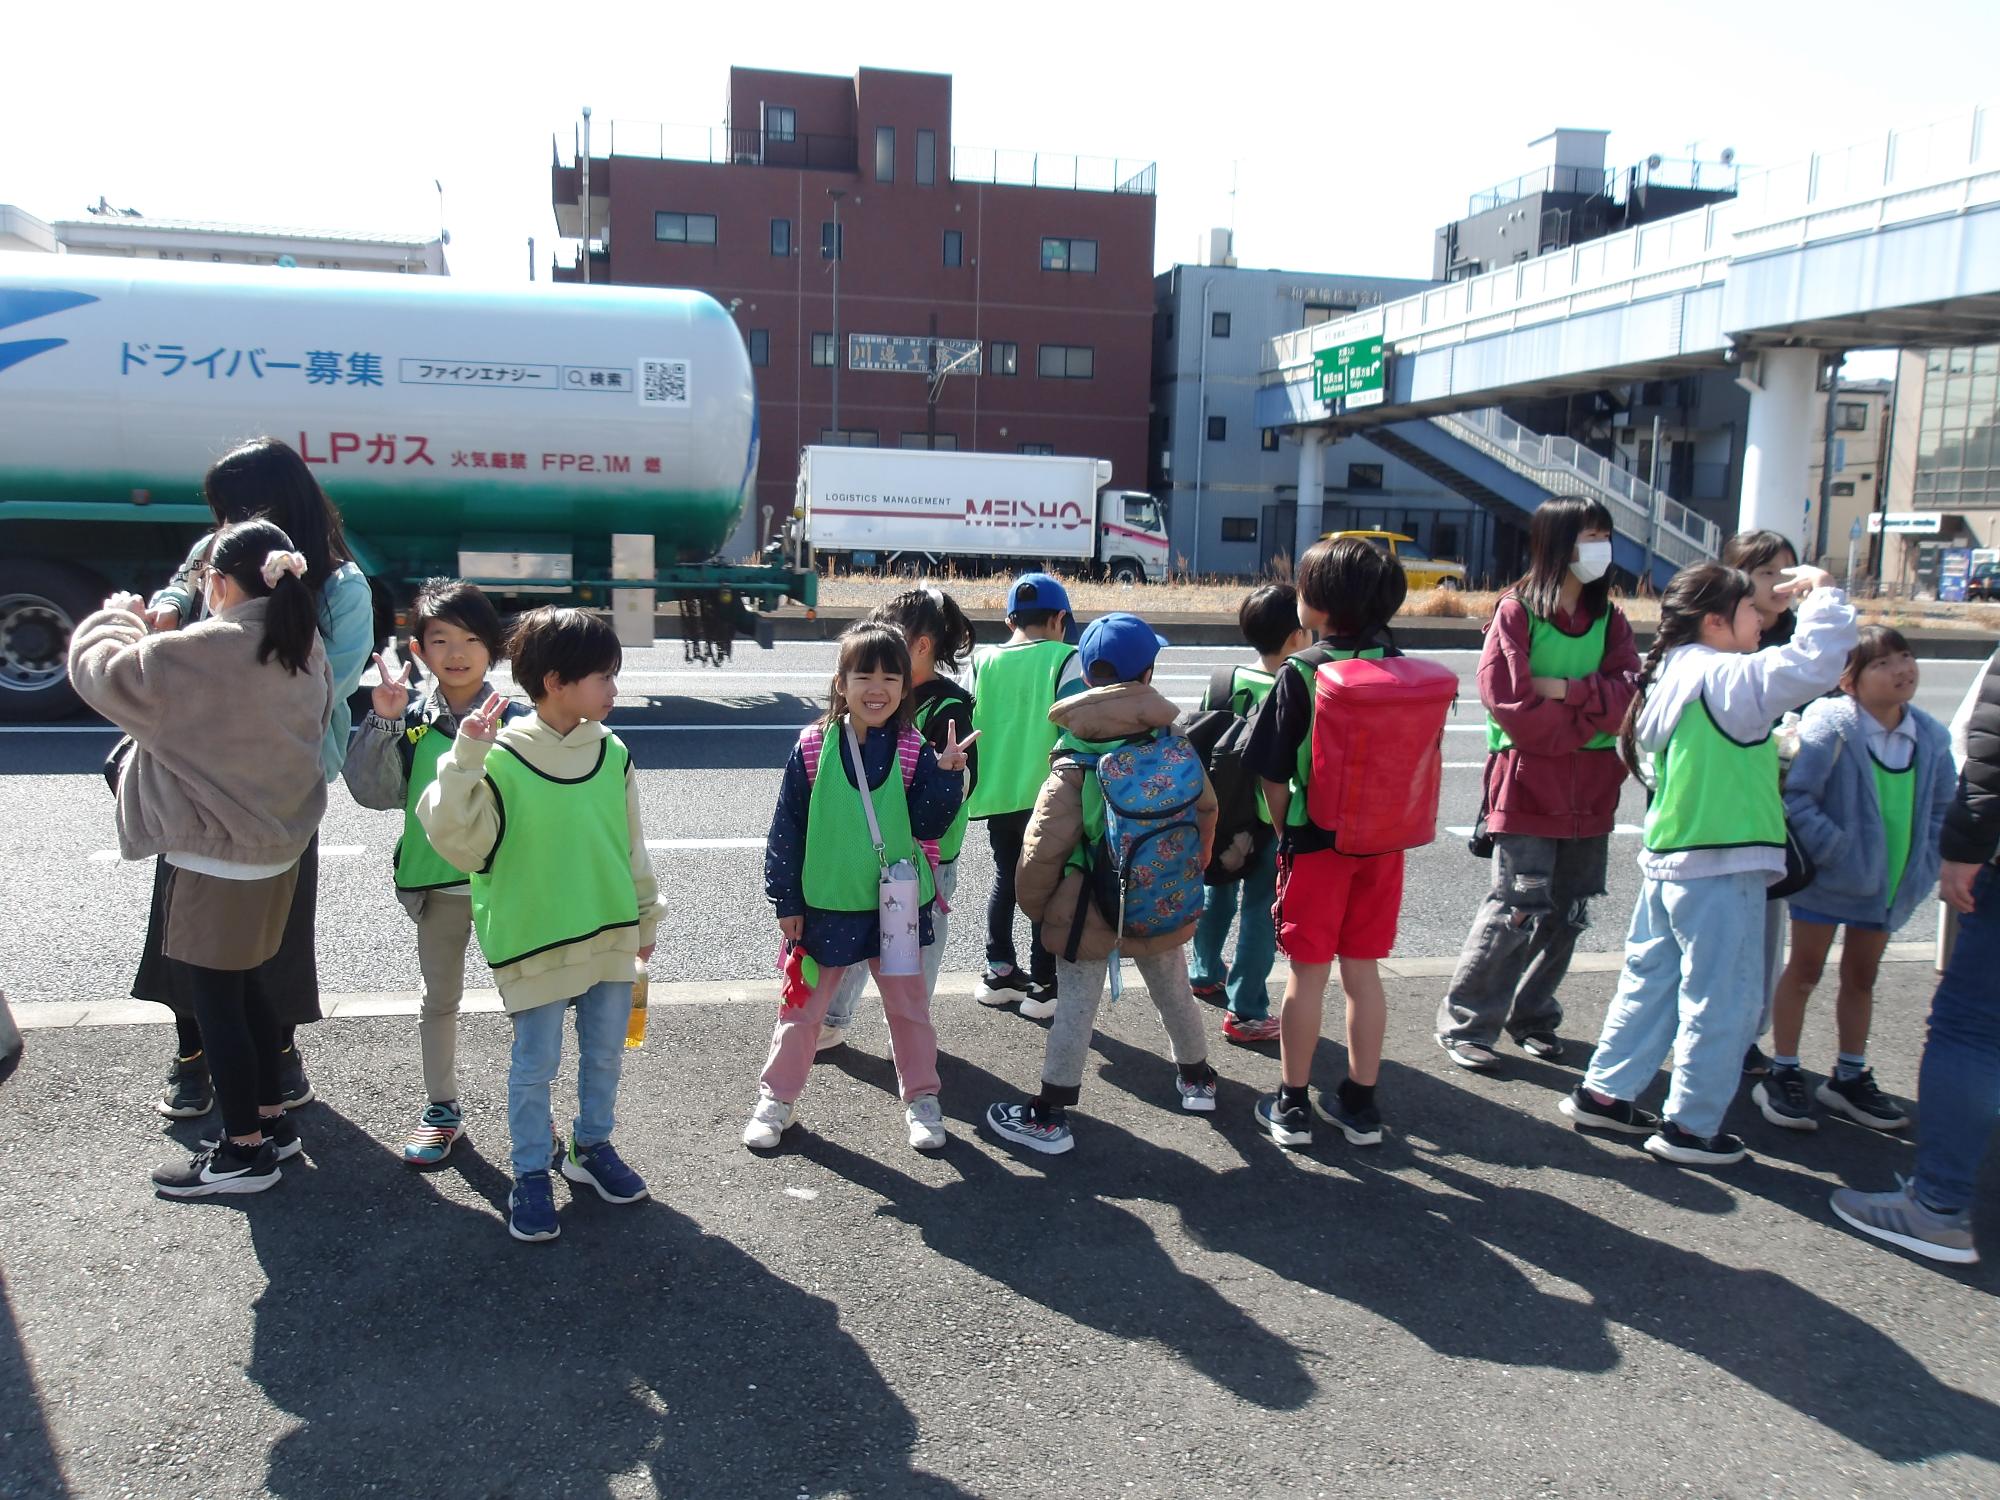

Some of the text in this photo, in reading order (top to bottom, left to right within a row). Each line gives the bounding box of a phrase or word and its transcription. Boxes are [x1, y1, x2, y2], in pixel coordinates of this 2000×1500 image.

[120, 341, 384, 387] ドライバー募集
[419, 364, 622, 387] ファインエナジー 検索
[299, 431, 435, 467] LPガス
[451, 450, 527, 470] 火気厳禁
[542, 453, 631, 474] FP2.1M
[825, 493, 952, 506] LOGISTICS MANAGEMENT
[966, 499, 1081, 530] MEISHO
